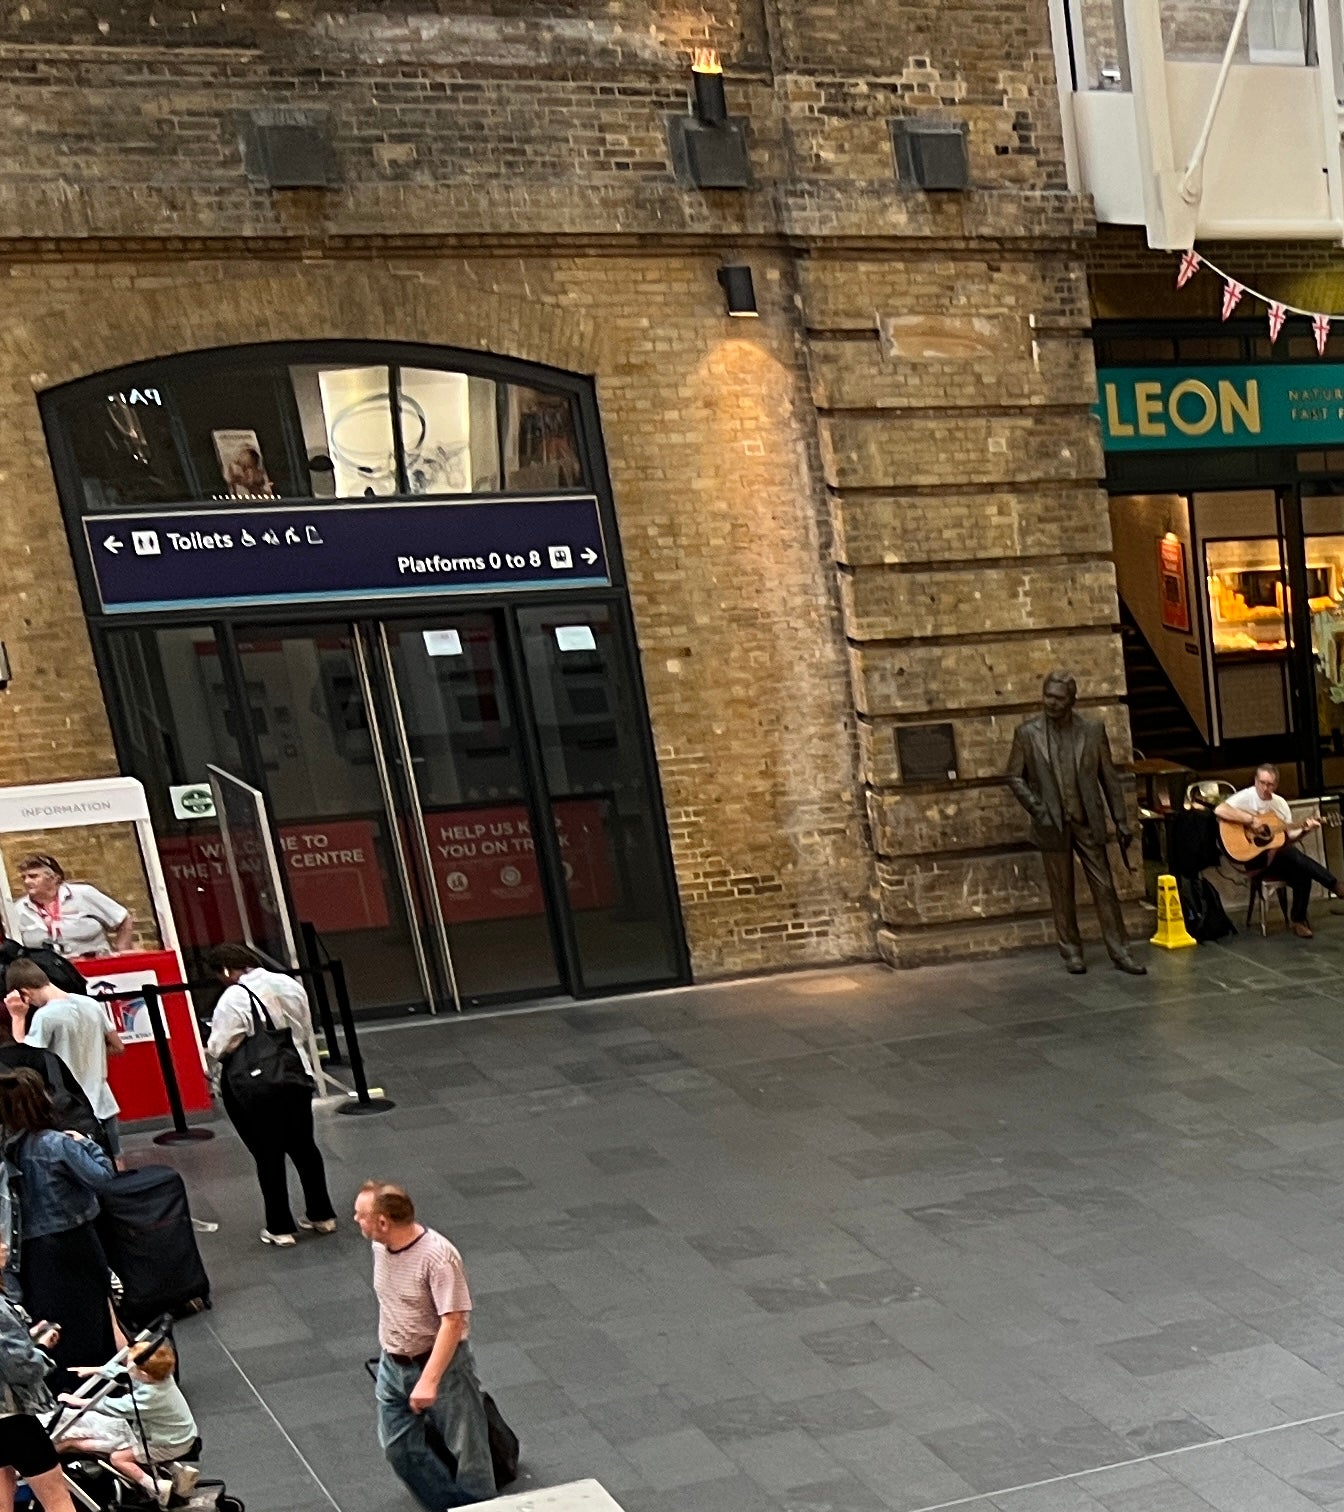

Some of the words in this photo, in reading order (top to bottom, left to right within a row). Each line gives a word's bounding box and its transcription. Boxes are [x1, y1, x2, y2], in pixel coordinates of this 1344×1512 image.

[1105, 378, 1261, 437] LEON
[166, 531, 234, 551] Toilets
[397, 551, 486, 574] Platforms
[489, 551, 501, 571] 0
[505, 552, 525, 570] to
[529, 550, 542, 568] 8
[21, 801, 111, 818] INFORMATION
[440, 823, 486, 841] HELP
[489, 821, 514, 837] US
[517, 817, 562, 835] KP
[302, 834, 329, 849] TO
[437, 842, 477, 859] YOU
[481, 839, 508, 855] ON
[510, 834, 570, 851] TRK
[170, 862, 209, 880] THE
[291, 848, 365, 868] CENTRE
